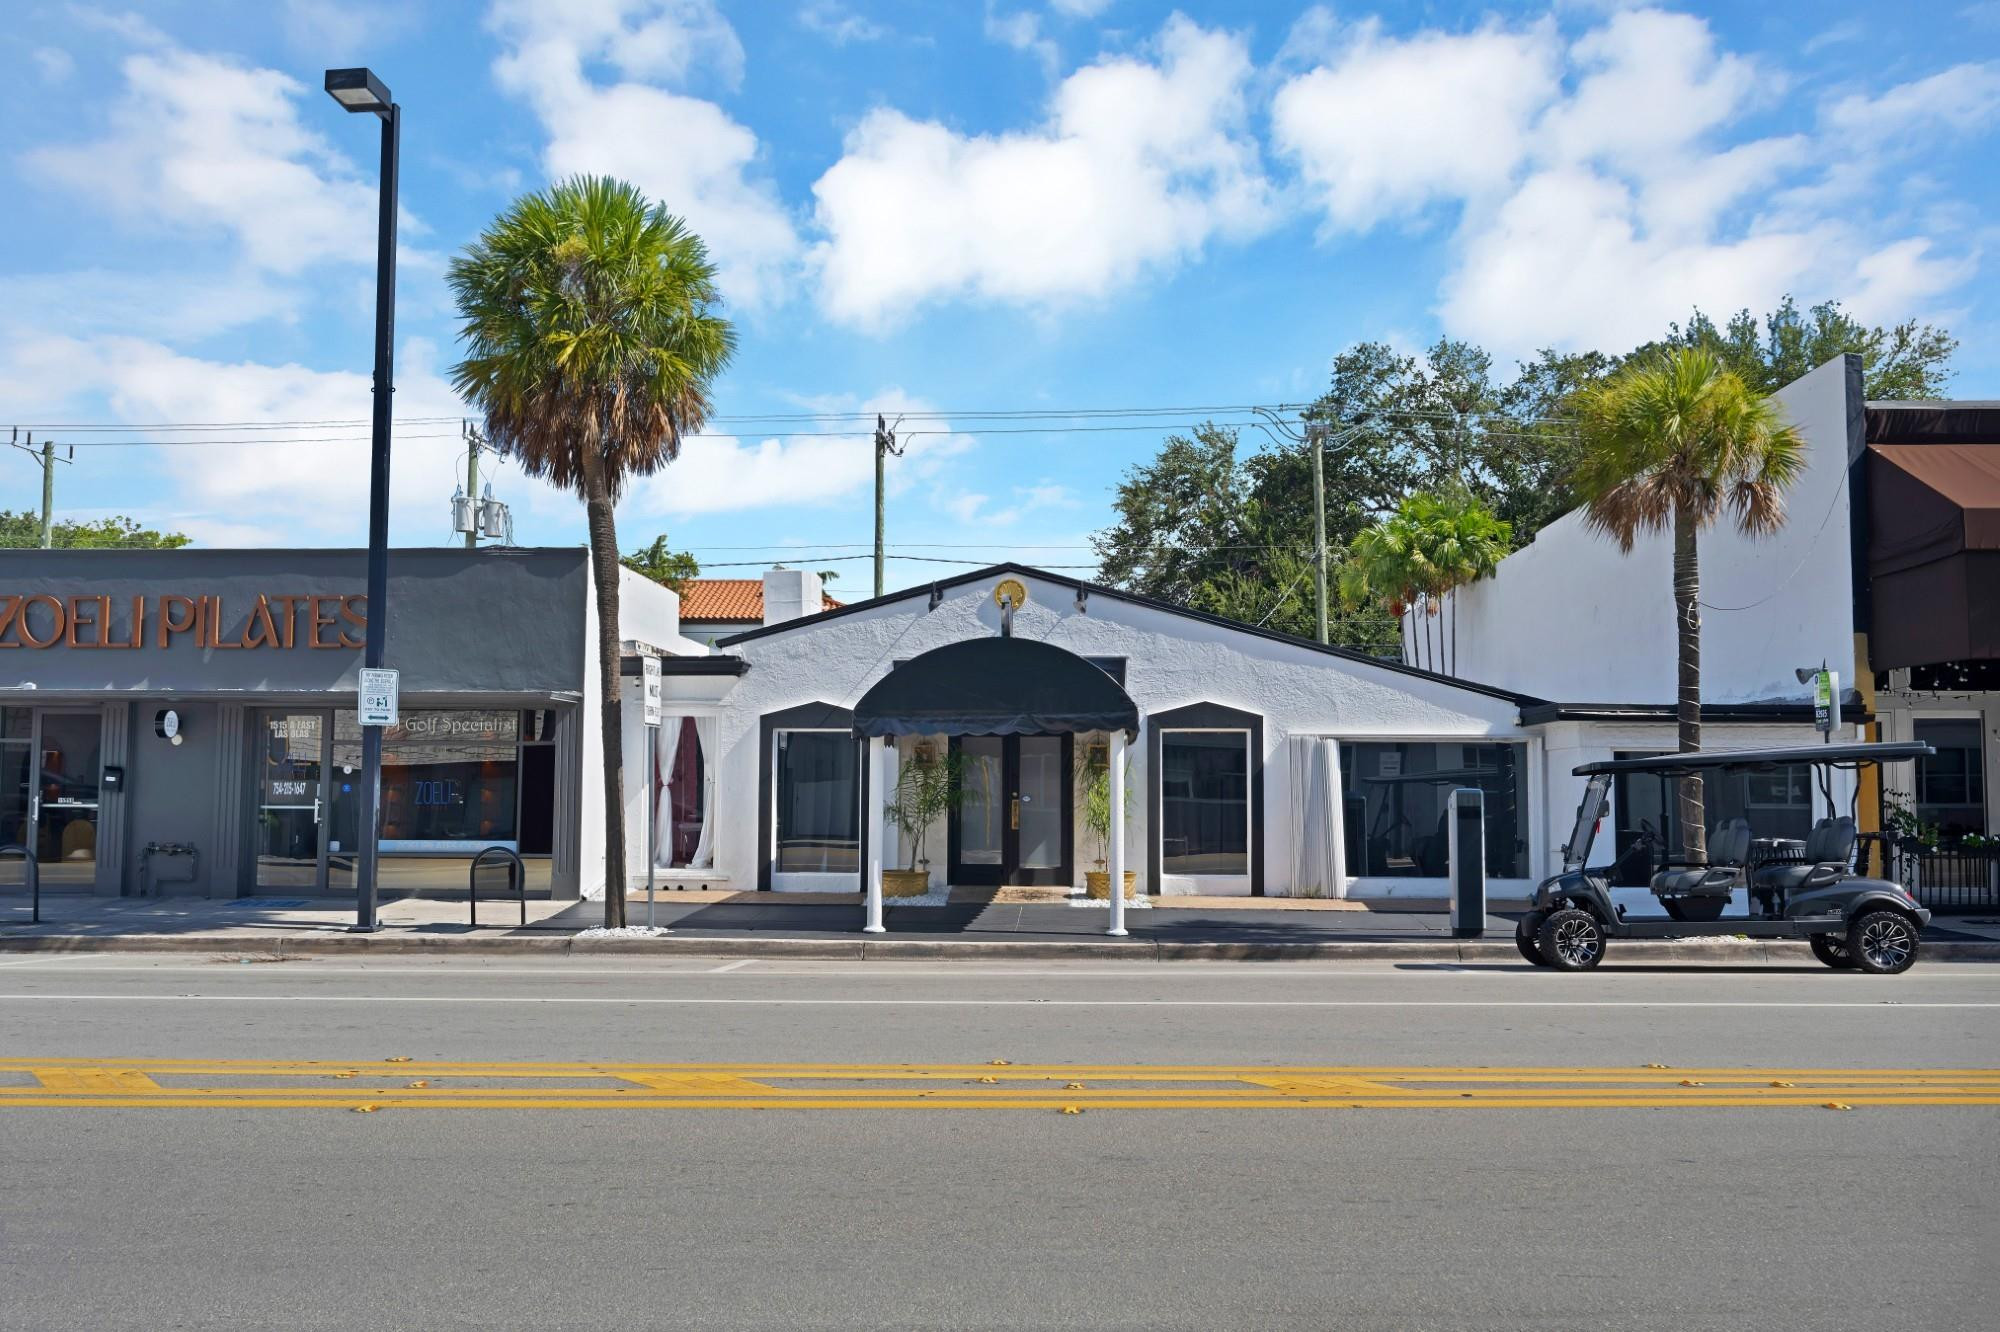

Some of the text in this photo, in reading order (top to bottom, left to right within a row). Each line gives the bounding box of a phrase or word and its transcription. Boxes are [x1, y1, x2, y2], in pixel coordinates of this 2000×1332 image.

[0, 594, 368, 649] ZOELI PILATES
[274, 729, 289, 738] LAS
[405, 717, 437, 734] Golf
[440, 717, 517, 734] Specialist
